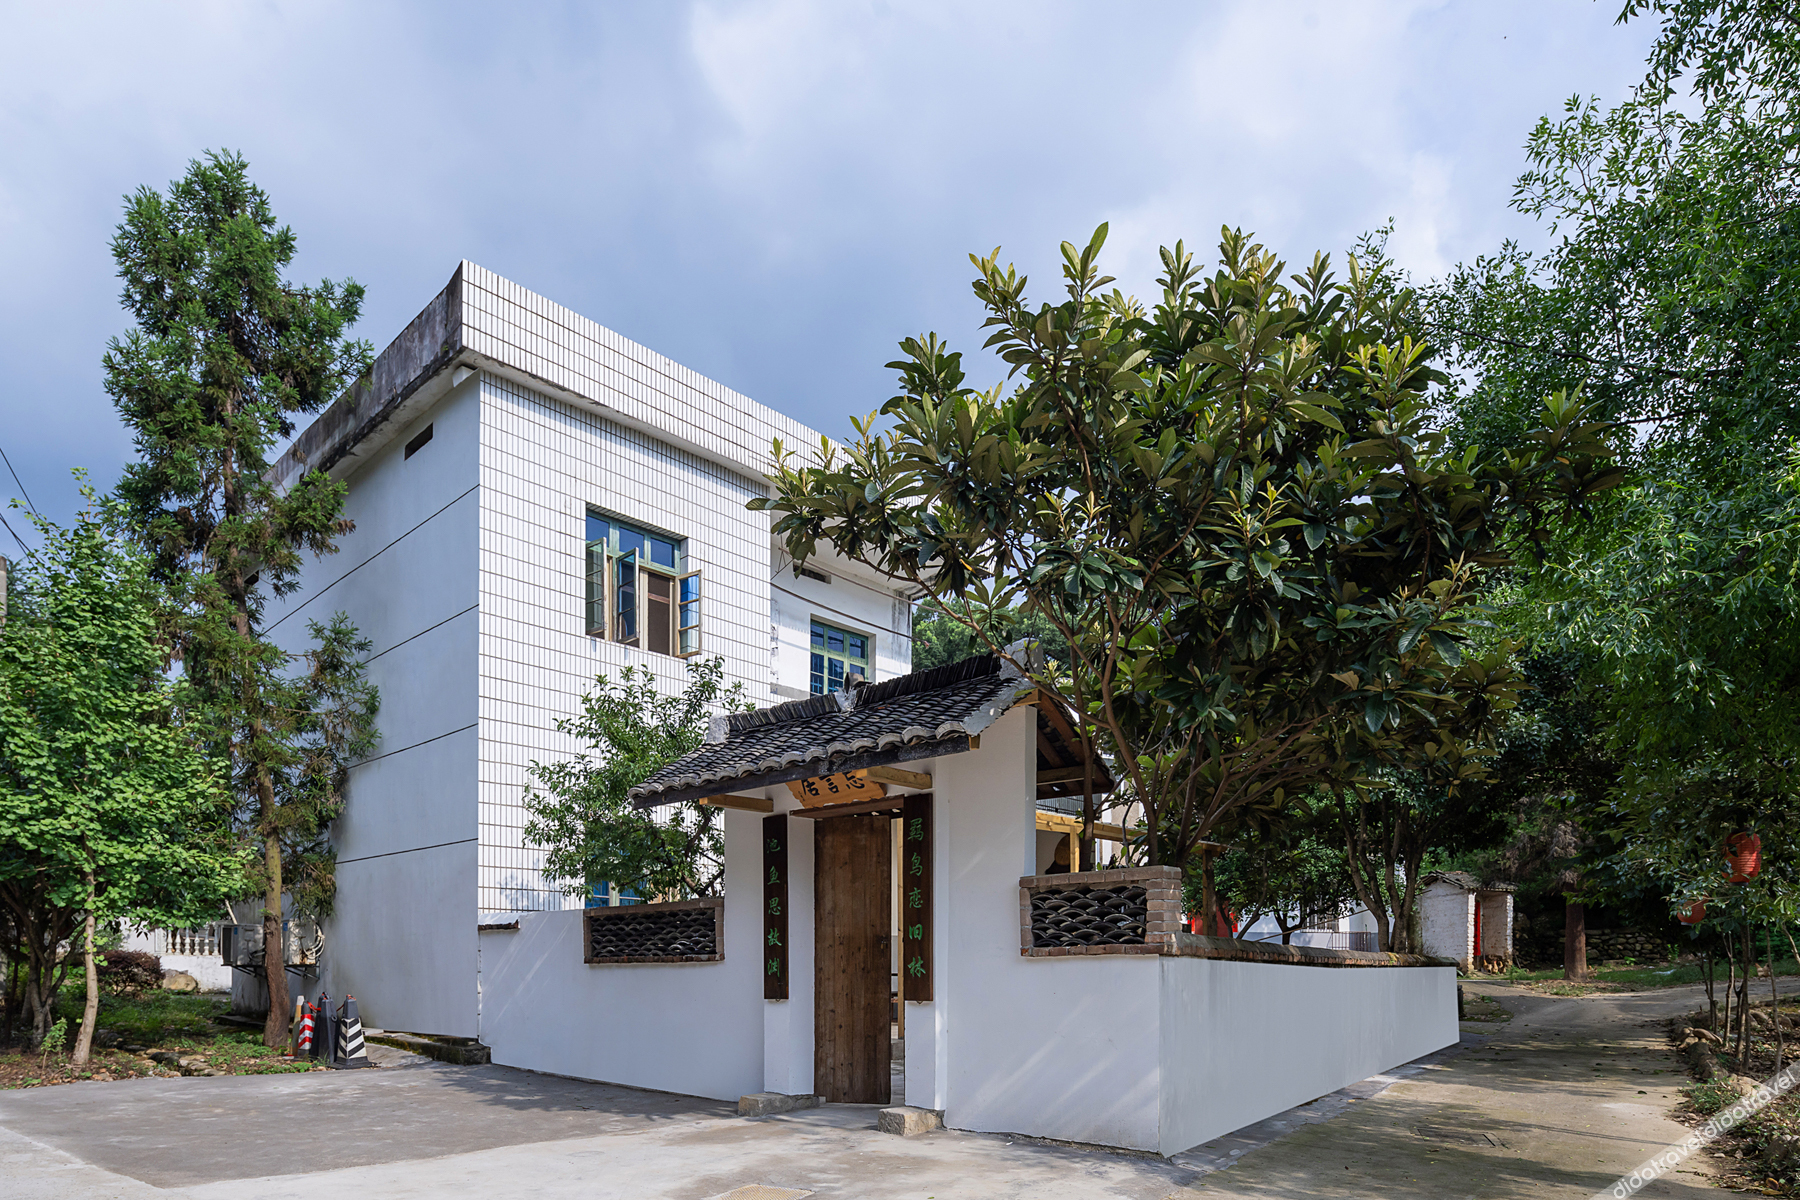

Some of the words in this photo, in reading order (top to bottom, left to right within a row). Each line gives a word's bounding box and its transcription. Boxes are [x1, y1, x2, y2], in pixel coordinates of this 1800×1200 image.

[766, 838, 782, 978] 池鱼思故渊
